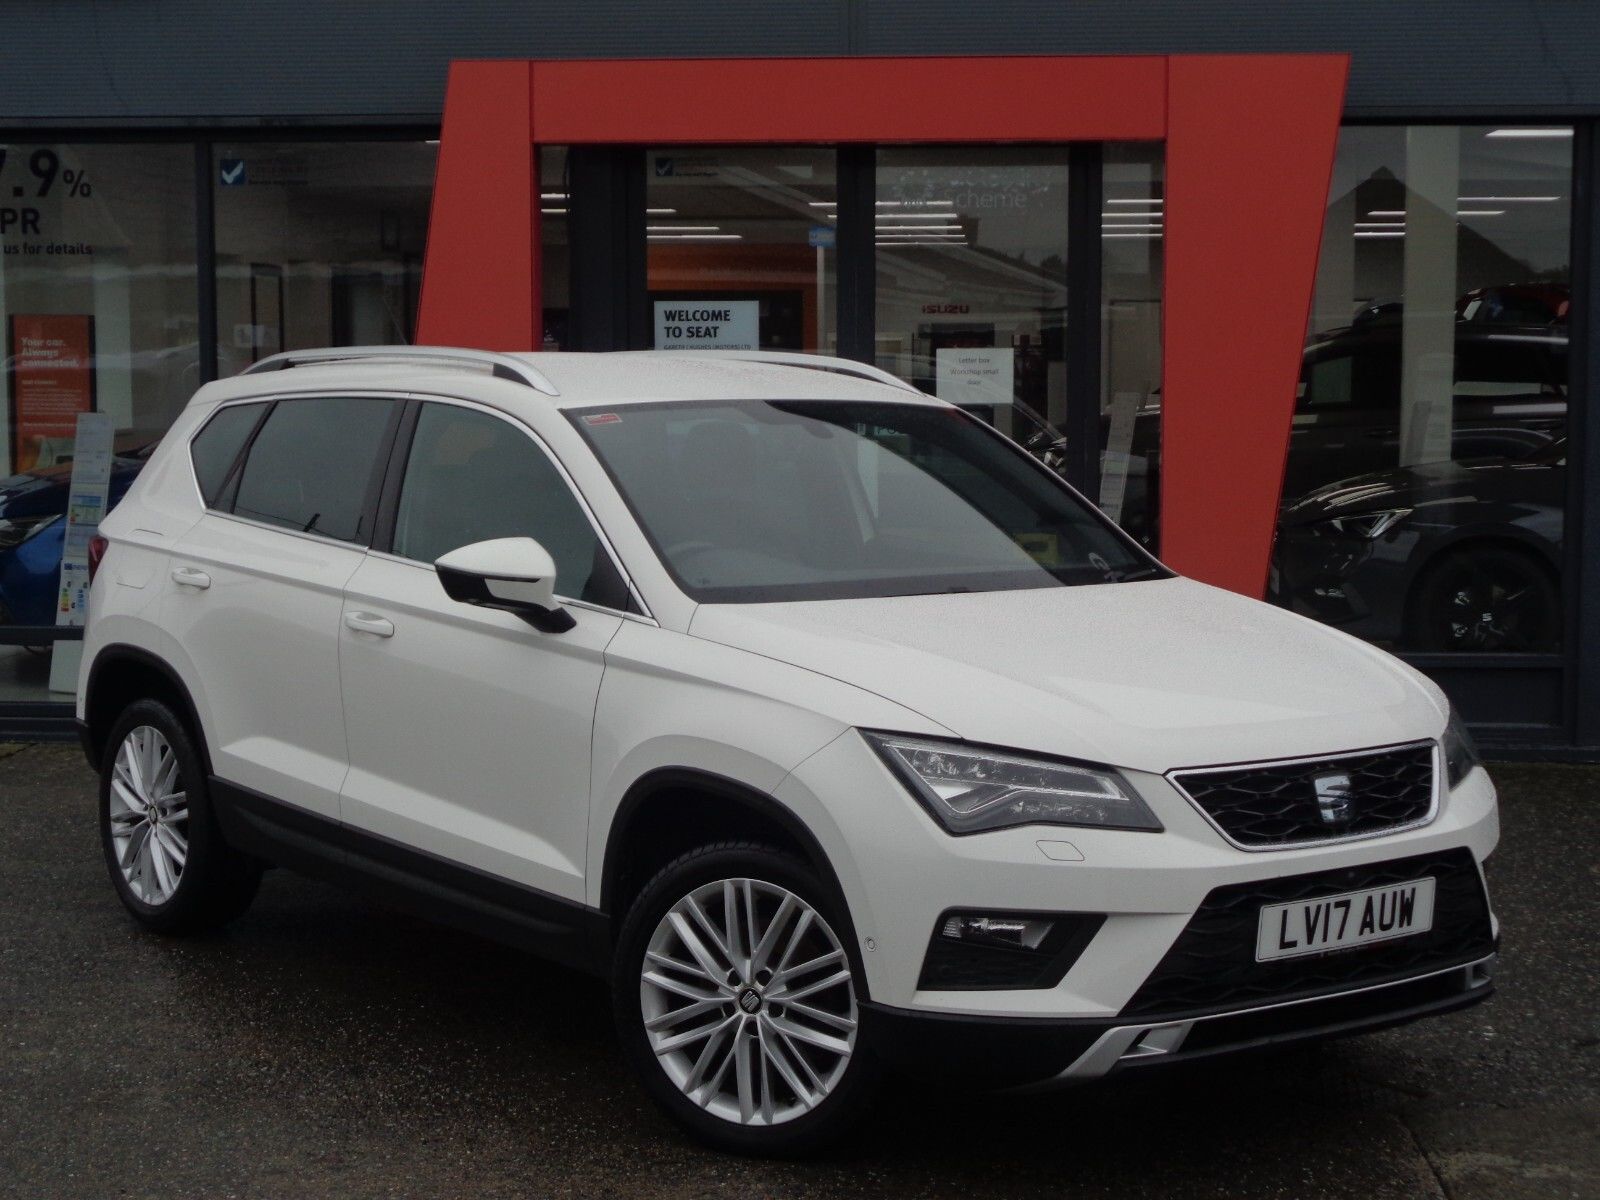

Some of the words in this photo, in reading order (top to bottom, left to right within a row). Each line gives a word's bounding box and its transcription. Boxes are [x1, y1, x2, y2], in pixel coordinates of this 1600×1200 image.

[3, 244, 19, 255] us
[22, 240, 42, 255] for
[46, 240, 93, 255] details
[664, 310, 731, 322] WELCOME
[664, 326, 682, 339] TO
[686, 326, 720, 339] SEAT
[1278, 898, 1352, 950] LV17
[1358, 887, 1417, 937] AUW
